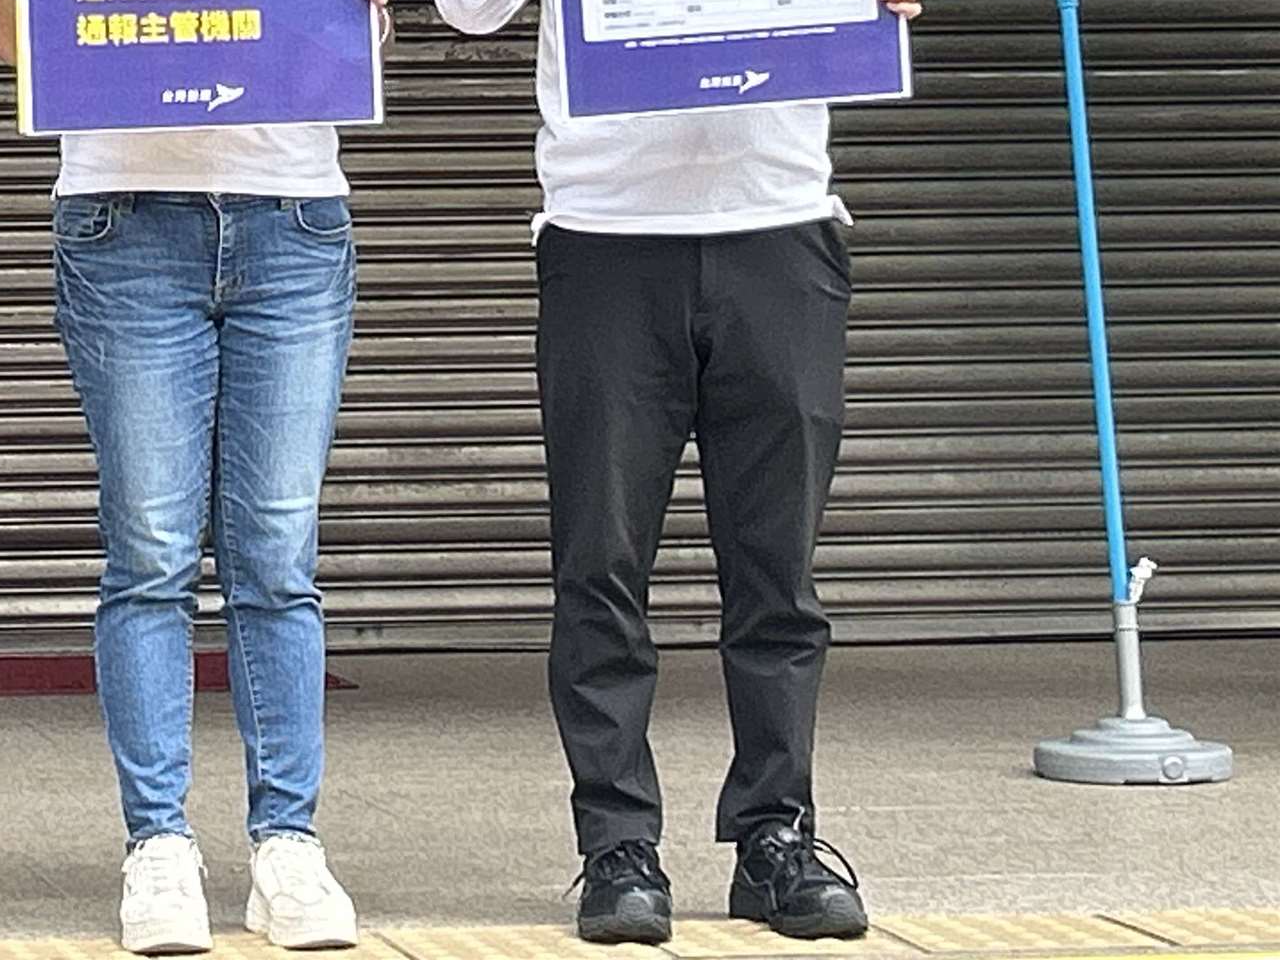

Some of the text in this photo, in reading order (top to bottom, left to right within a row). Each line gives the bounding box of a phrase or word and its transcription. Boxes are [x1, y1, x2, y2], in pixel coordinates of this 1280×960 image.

[76, 9, 262, 47] 通報主管機關
